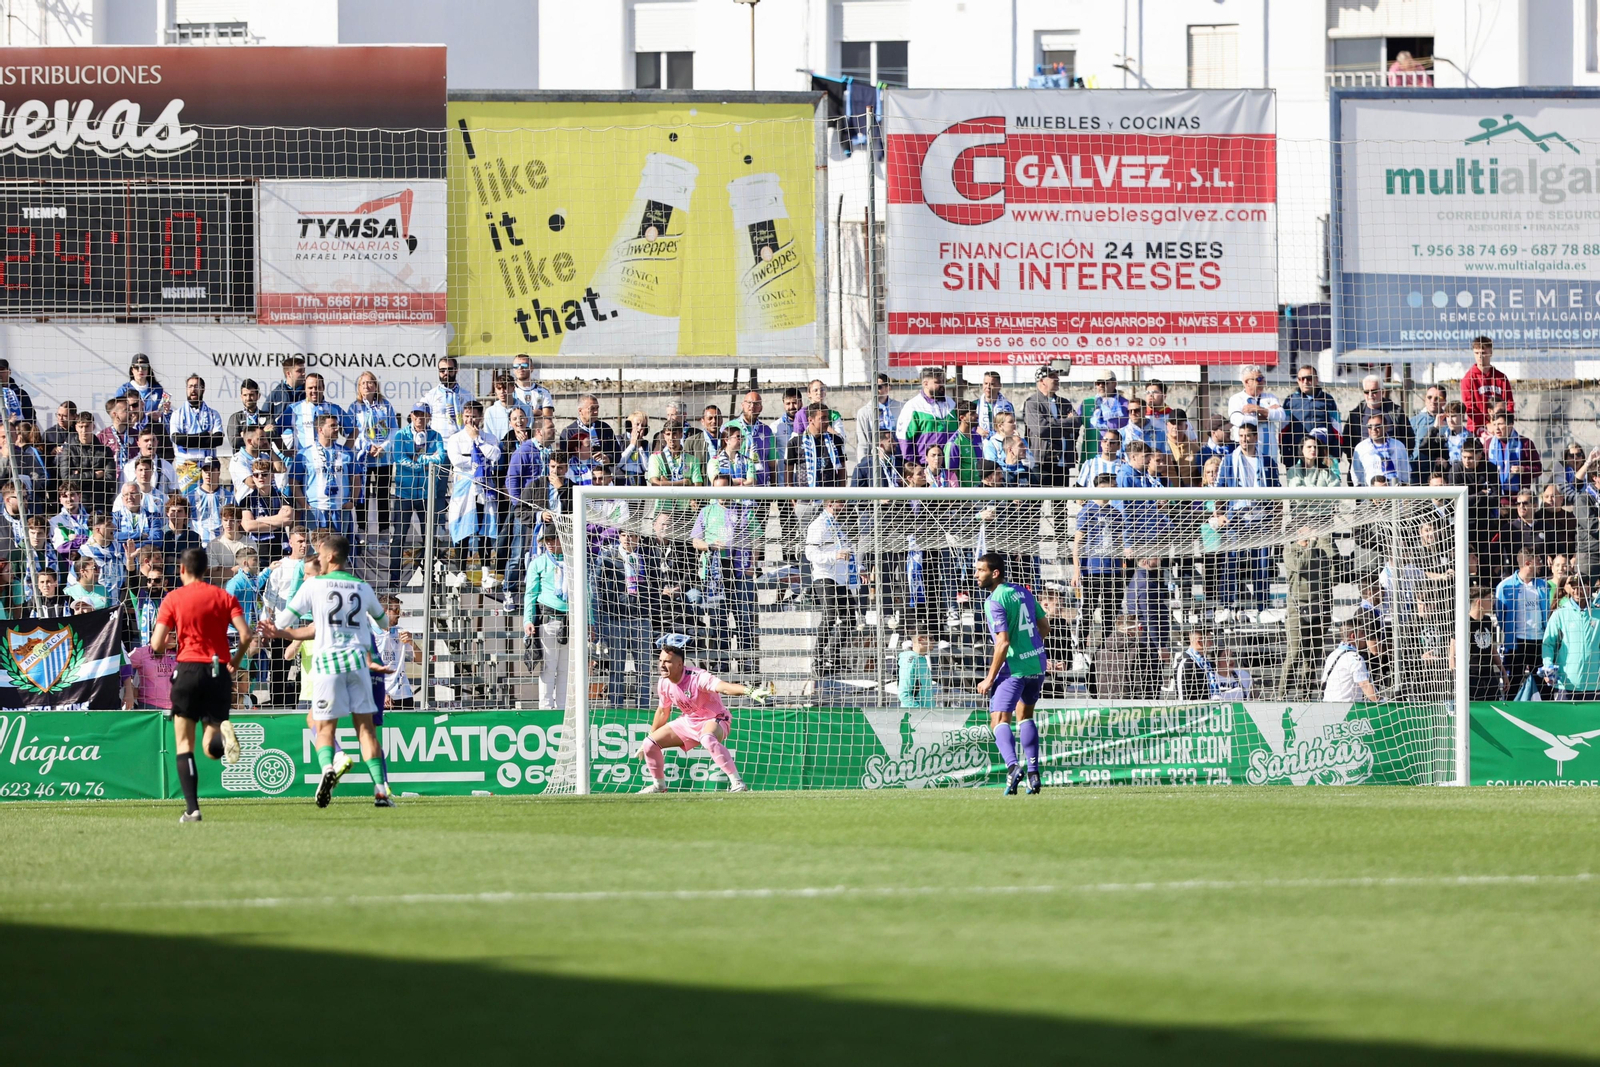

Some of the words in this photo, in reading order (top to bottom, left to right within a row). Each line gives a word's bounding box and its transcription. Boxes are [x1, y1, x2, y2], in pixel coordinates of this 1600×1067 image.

[1016, 116, 1101, 130] MUEBLES
[1120, 116, 1201, 130] COCINAS
[458, 118, 475, 159] I
[471, 157, 549, 206] like
[1190, 168, 1235, 187] S.L.
[22, 207, 67, 219] TIEMPO
[1012, 207, 1267, 225] www.mueblesgalvez.com
[1437, 210, 1522, 221] CORREDURÍA
[1526, 211, 1544, 220] DE
[297, 218, 399, 238] TYMSA
[485, 211, 524, 252] it
[1467, 223, 1520, 232] ASESORES
[1530, 223, 1580, 231] FINANZAS
[164, 211, 202, 275] 0
[297, 241, 400, 252] MAQUINARIAS
[616, 240, 680, 257] Schweppes
[940, 239, 1093, 260] FINANCIACIÓN
[1105, 242, 1134, 259] 24
[1146, 242, 1223, 259] MESES
[1412, 244, 1423, 256] T.
[1427, 244, 1453, 256] 956
[1458, 244, 1475, 256] 38
[1479, 244, 1496, 256] 74
[1500, 244, 1517, 256] 69
[1531, 244, 1557, 256] 687
[1562, 244, 1579, 256] 78
[1583, 244, 1600, 256] 88
[498, 250, 576, 299] like
[744, 247, 797, 295] Schweppes
[1465, 260, 1586, 273] www.multialgaida.es
[620, 277, 654, 291] ORIGINAL
[942, 262, 999, 291] SIN
[1019, 262, 1222, 291] INTERESES
[161, 287, 207, 299] VISITANTE
[295, 295, 324, 307] Tlfn.
[327, 295, 350, 307] 666
[354, 296, 368, 307] 71
[373, 296, 389, 307] 85
[392, 296, 408, 307] 33
[1481, 289, 1600, 308] REME
[761, 299, 795, 310] ORIGINAL
[270, 310, 433, 322] tymsamaquinarias@gmail.com
[514, 287, 618, 343] that.
[908, 317, 935, 328] POL.
[940, 317, 963, 328] IND.
[968, 317, 990, 328] LAS
[994, 317, 1057, 328] PALMERAS
[1071, 317, 1085, 328] C/
[1090, 317, 1166, 328] ALGARROBO
[1178, 317, 1218, 327] NAVES
[1222, 317, 1231, 327] 4
[1236, 317, 1244, 327] Y
[1249, 317, 1257, 327] 6
[1440, 313, 1495, 322] REMECO
[976, 336, 1001, 348] 956
[1007, 336, 1024, 348] 96
[1030, 336, 1047, 348] 60
[1052, 336, 1069, 348] 00
[1096, 336, 1120, 347] 661
[1127, 336, 1143, 347] 92
[1149, 336, 1166, 347] 09
[1174, 336, 1188, 347] 11
[1401, 329, 1521, 341] RECONOCIMIENTOS
[1523, 327, 1579, 340] MÉDICOS
[1076, 354, 1092, 364] DE
[1097, 354, 1171, 364] BARRAMEDA
[355, 375, 433, 399] iente
[326, 591, 362, 629] 22
[1019, 603, 1035, 638] 4
[1058, 709, 1100, 737] VIVO
[1108, 708, 1140, 736] POR
[1150, 704, 1232, 735] ENCARGO
[1323, 718, 1375, 740] PESCA
[303, 714, 577, 763] EMÁTICOS
[942, 725, 995, 746] PESCA
[861, 743, 987, 789] Sanlúcar
[1246, 736, 1368, 785] Sanlúcar
[593, 764, 631, 783] 79
[690, 763, 732, 782] 62
[1, 782, 30, 797] 623
[34, 782, 54, 798] 46
[60, 782, 81, 796] 70
[86, 782, 104, 796] 76
